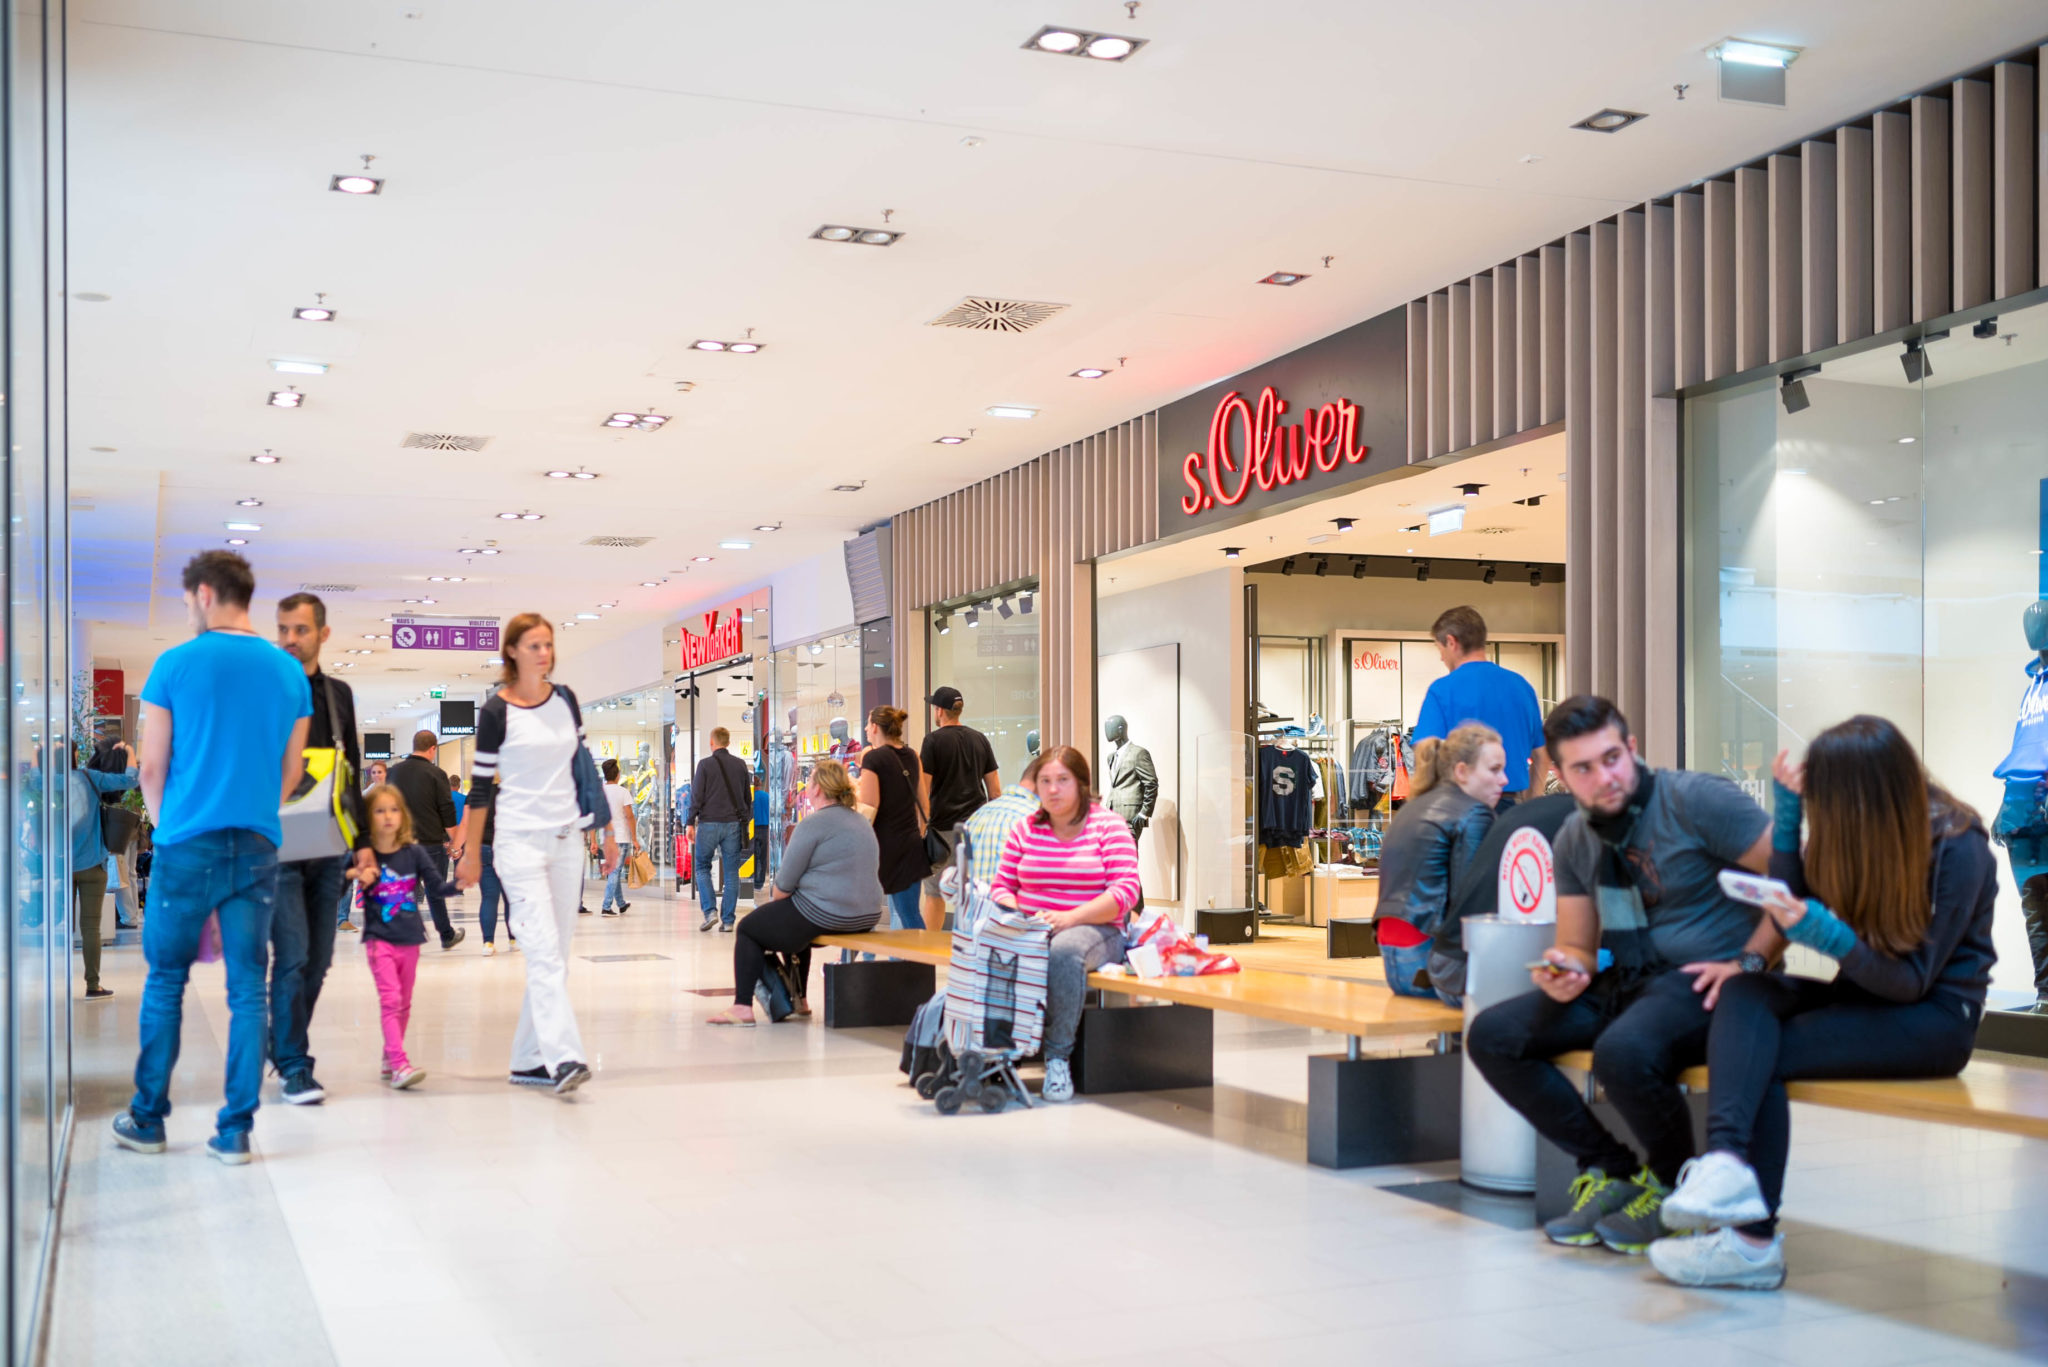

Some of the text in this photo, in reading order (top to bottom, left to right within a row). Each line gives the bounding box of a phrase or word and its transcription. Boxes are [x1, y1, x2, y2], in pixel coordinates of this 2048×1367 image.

[1181, 386, 1368, 515] s.Oliver
[1354, 651, 1399, 670] s.Oliver
[442, 726, 475, 734] HUMANIC
[1272, 765, 1296, 796] S
